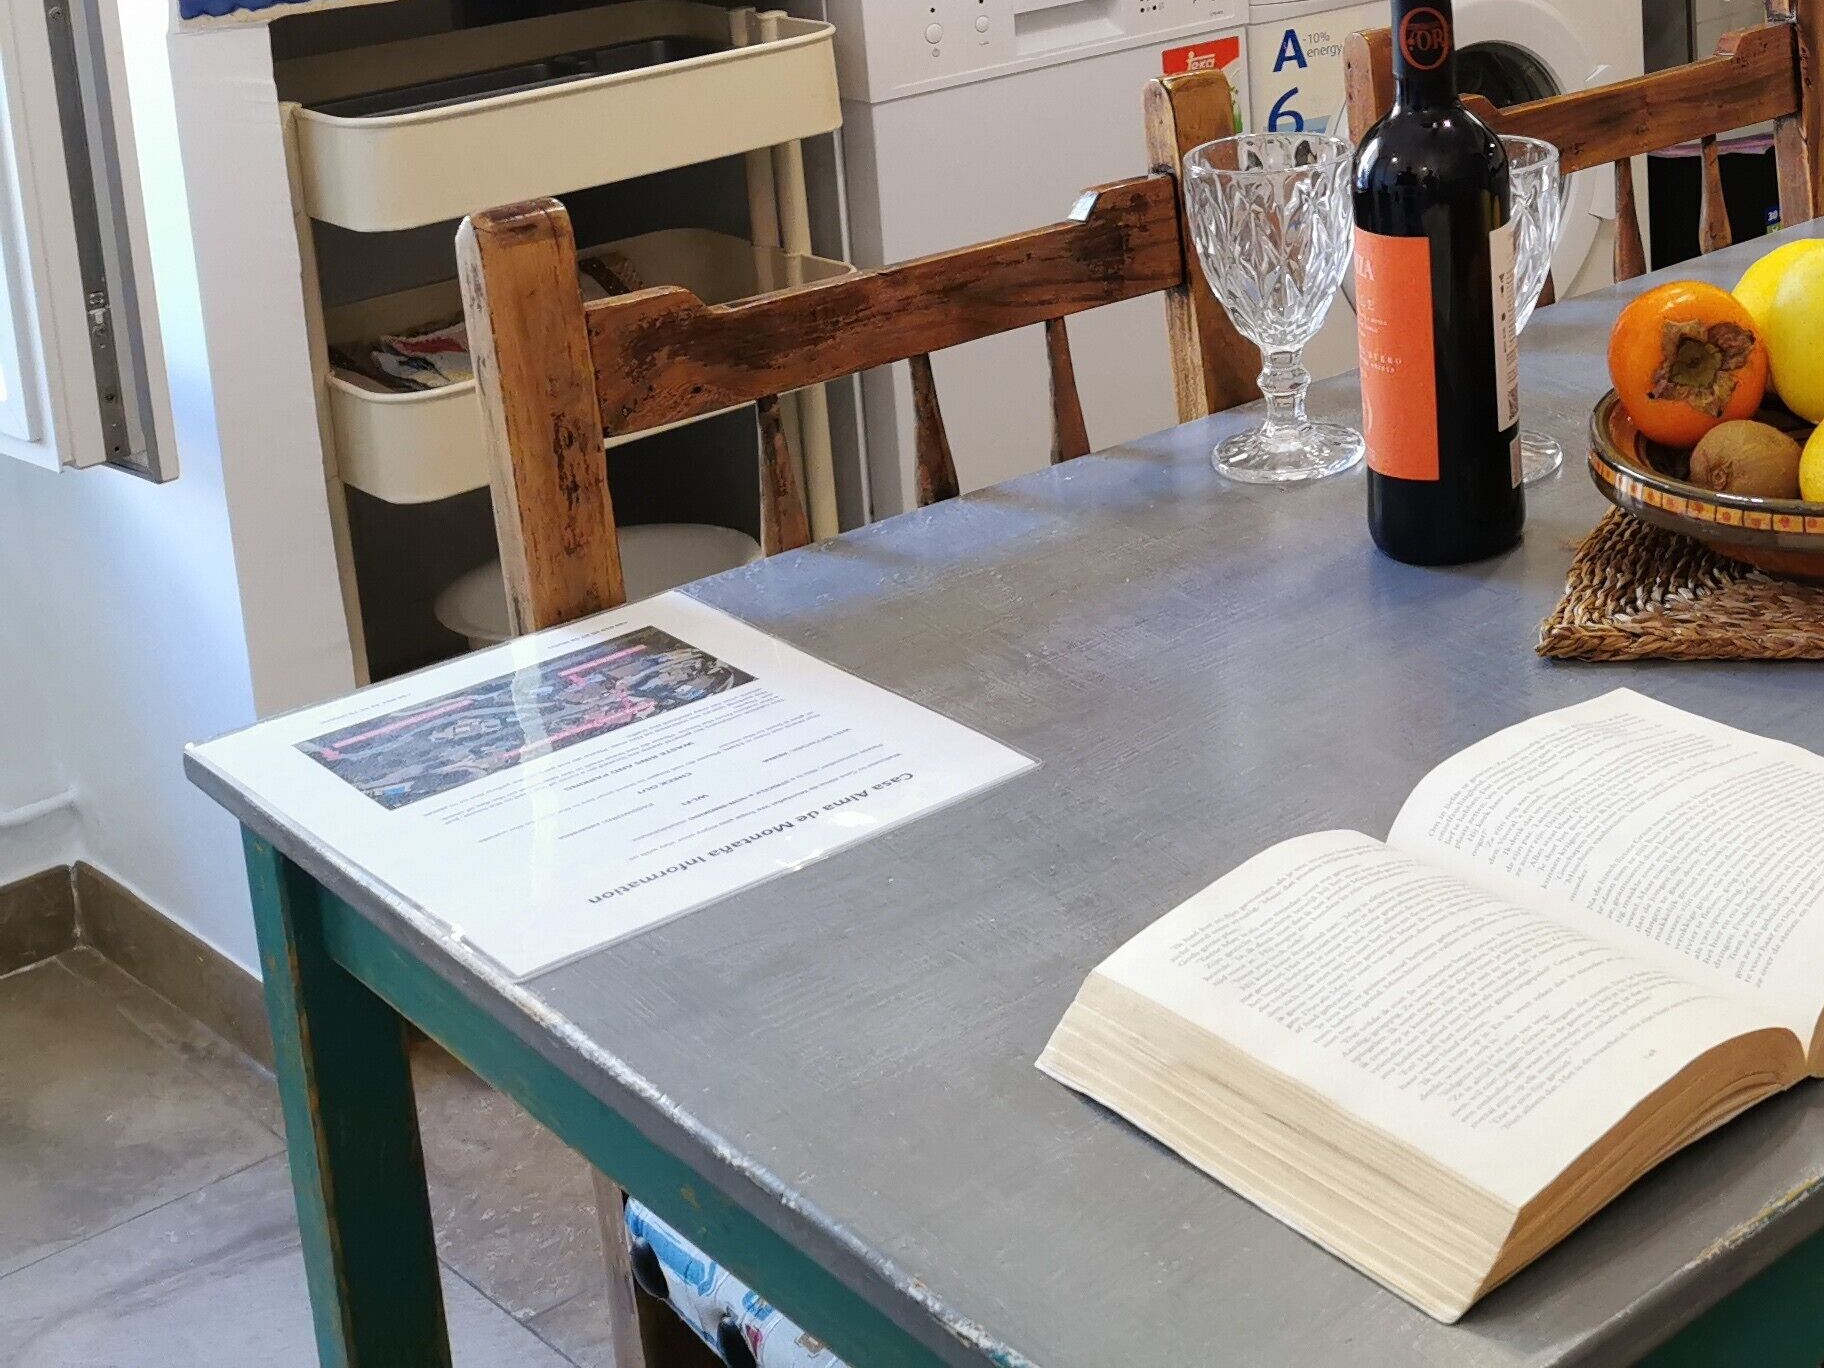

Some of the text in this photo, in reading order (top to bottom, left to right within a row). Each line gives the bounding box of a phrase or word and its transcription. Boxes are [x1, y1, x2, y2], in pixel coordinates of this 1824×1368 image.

[1303, 31, 1330, 44] -10%
[1272, 28, 1308, 73] A
[1306, 43, 1343, 58] energy
[660, 742, 694, 756] WASTE
[637, 772, 692, 795] CHECK OUT
[589, 773, 913, 903] Casa Alma de Montaña Information
